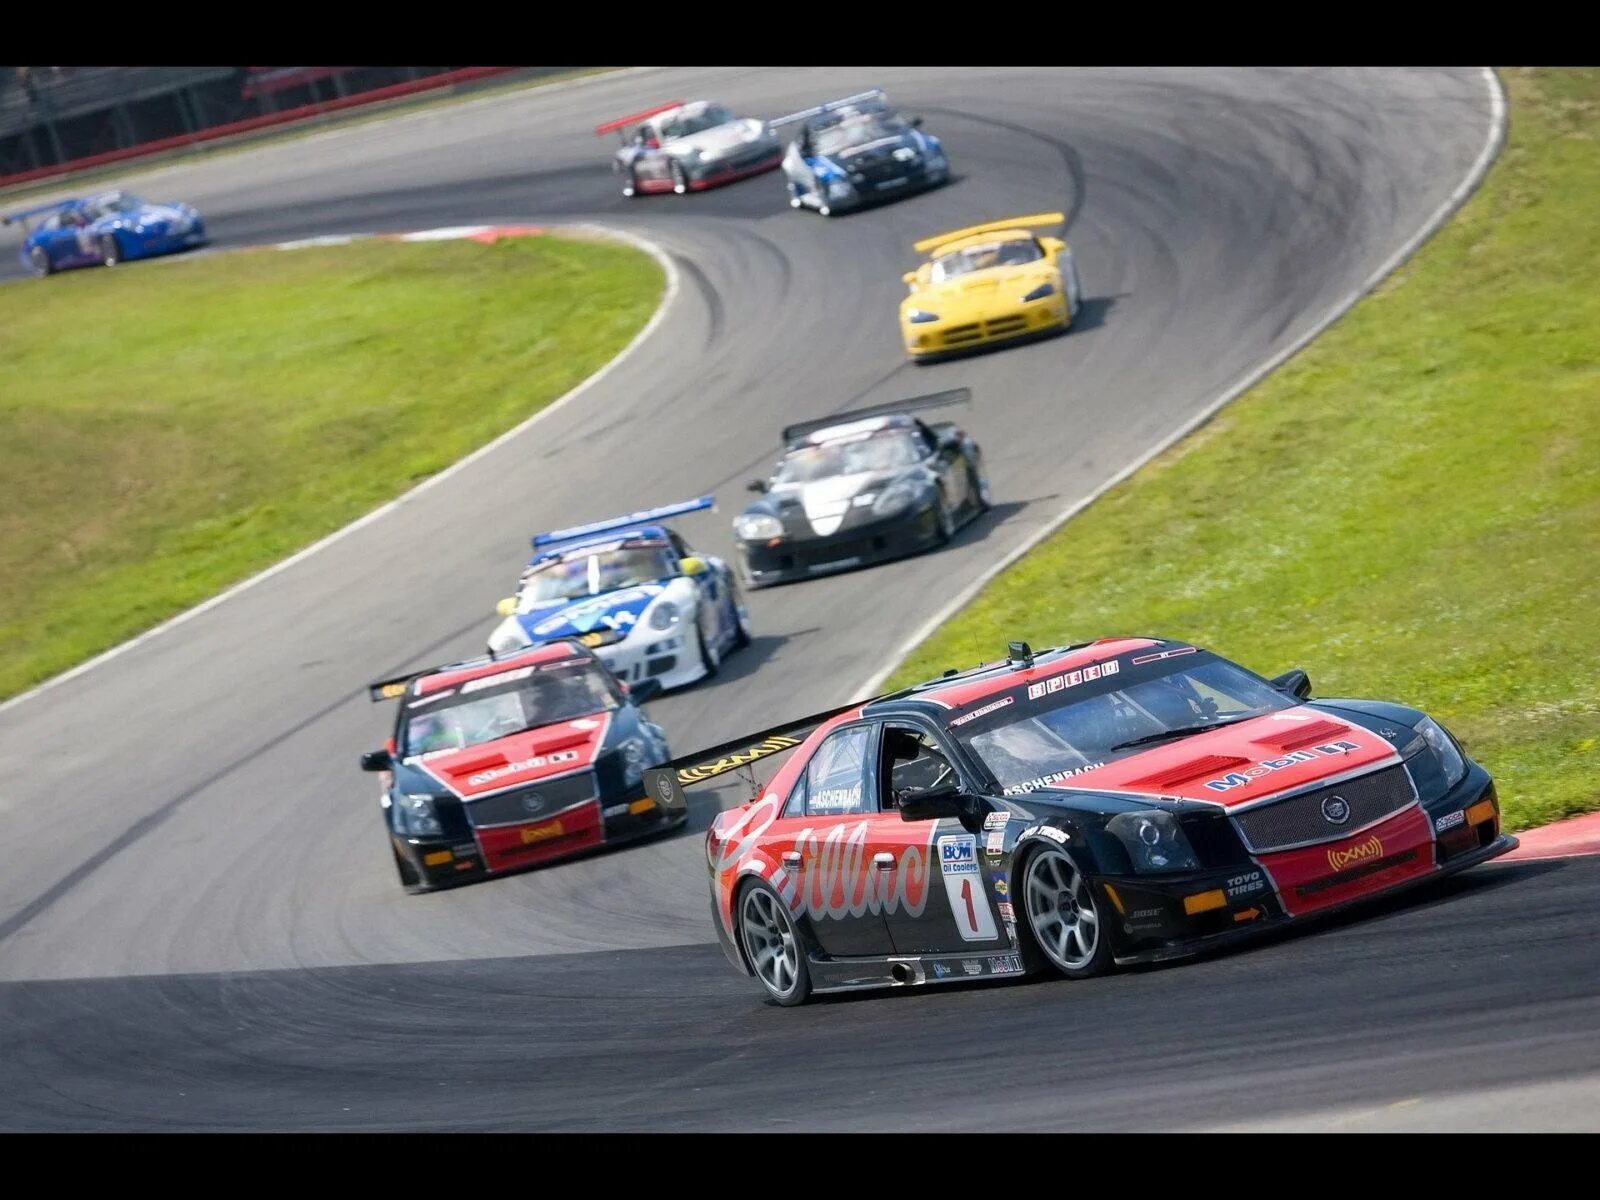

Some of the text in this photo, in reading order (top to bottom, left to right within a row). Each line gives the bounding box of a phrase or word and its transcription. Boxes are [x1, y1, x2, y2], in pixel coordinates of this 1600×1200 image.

[1203, 751, 1318, 792] Mobil
[943, 862, 977, 873] Oil Coolers
[1227, 871, 1260, 887] TOYO
[1228, 880, 1264, 897] TIRES
[961, 878, 978, 932] 1
